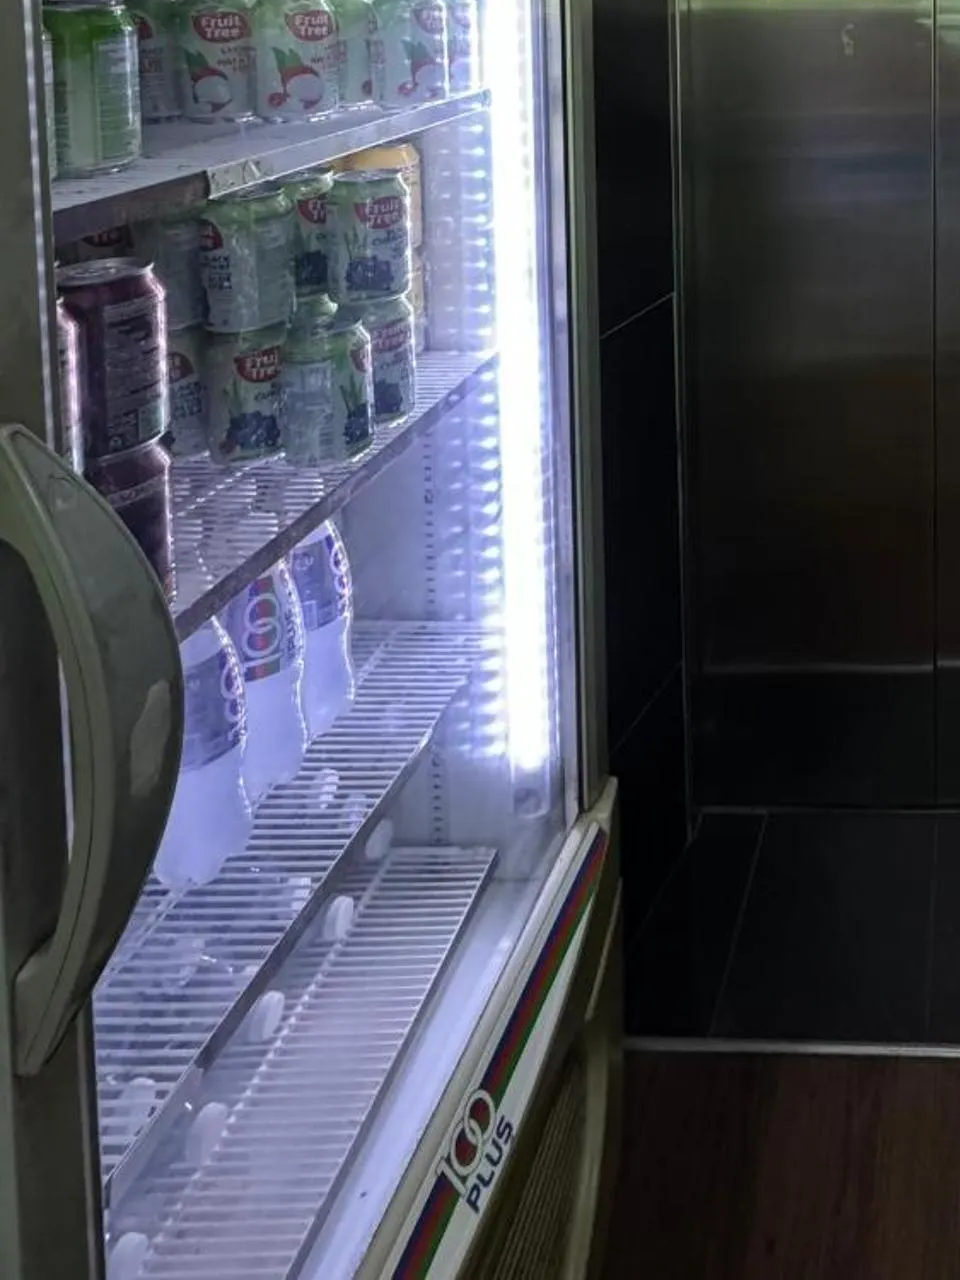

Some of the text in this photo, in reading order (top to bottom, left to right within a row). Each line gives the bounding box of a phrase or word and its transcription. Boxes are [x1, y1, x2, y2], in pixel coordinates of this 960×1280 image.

[200, 13, 241, 27] Fruit
[204, 27, 241, 38] Tree
[466, 1115, 514, 1214] PLUS
